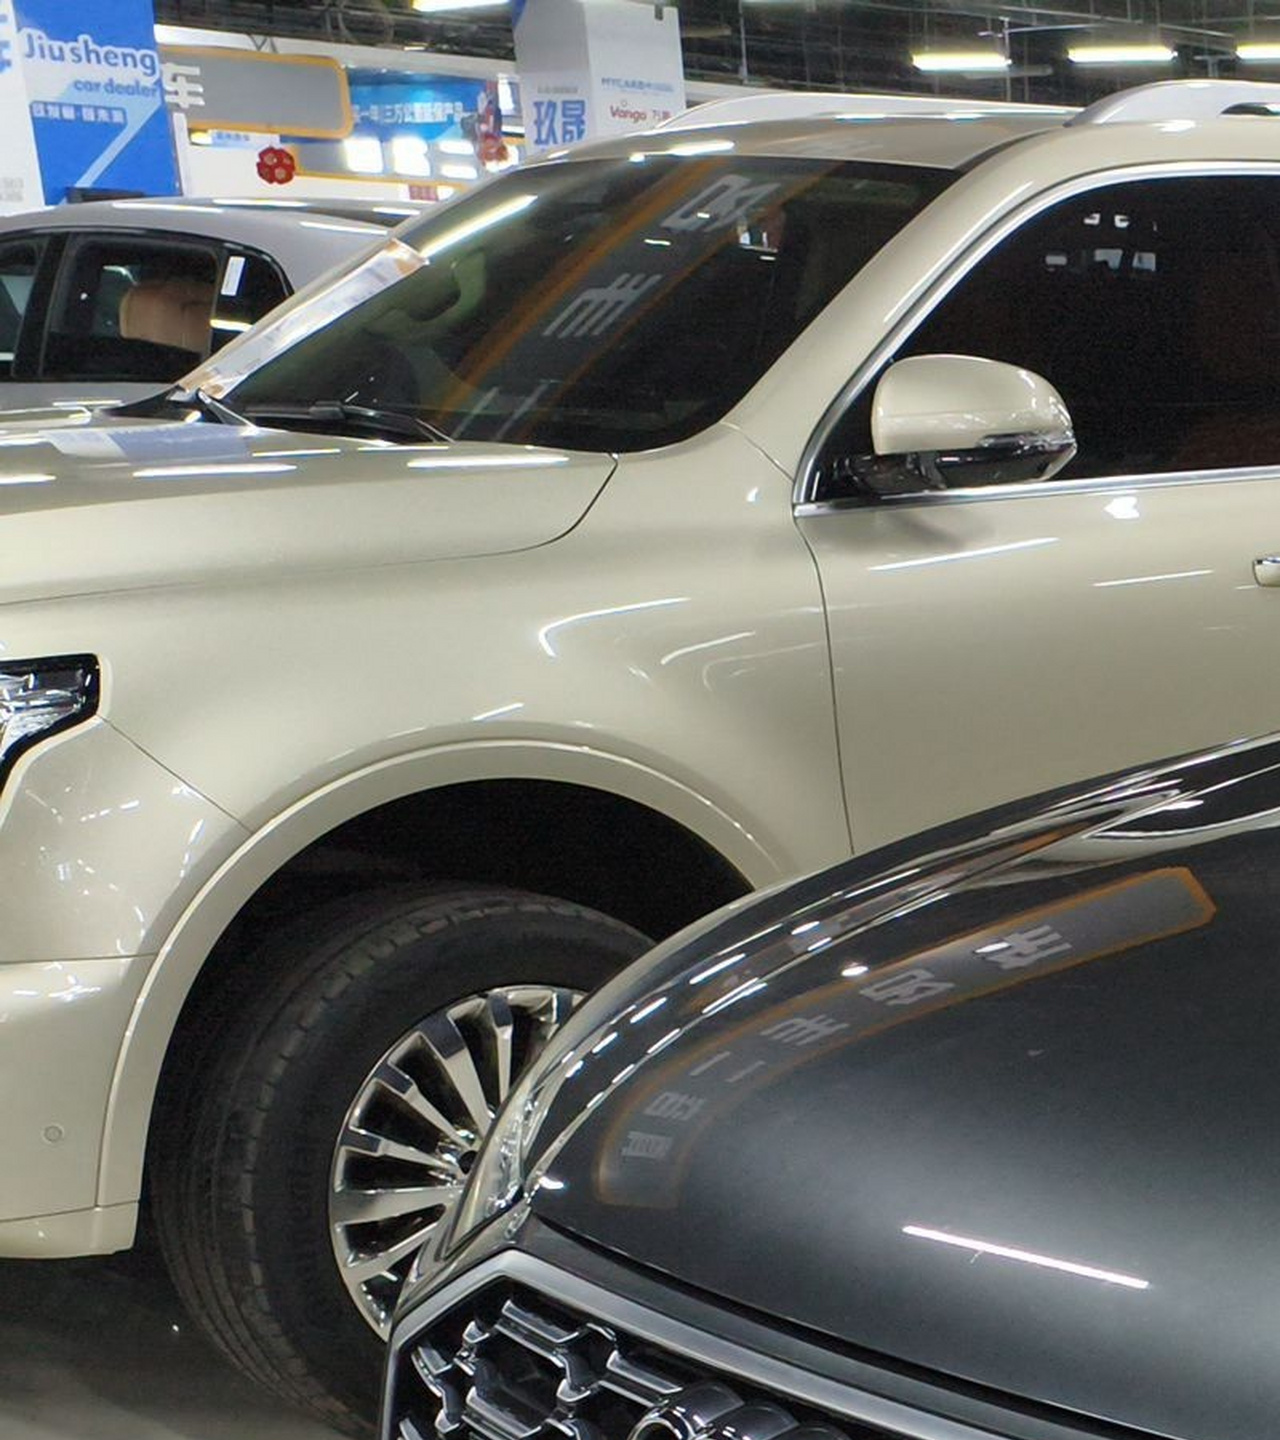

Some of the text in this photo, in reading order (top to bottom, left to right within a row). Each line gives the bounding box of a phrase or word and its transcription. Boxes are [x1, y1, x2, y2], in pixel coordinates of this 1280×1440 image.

[25, 33, 157, 76] Jiusheng
[73, 79, 158, 97] car dealer
[533, 99, 587, 145] 玖晟
